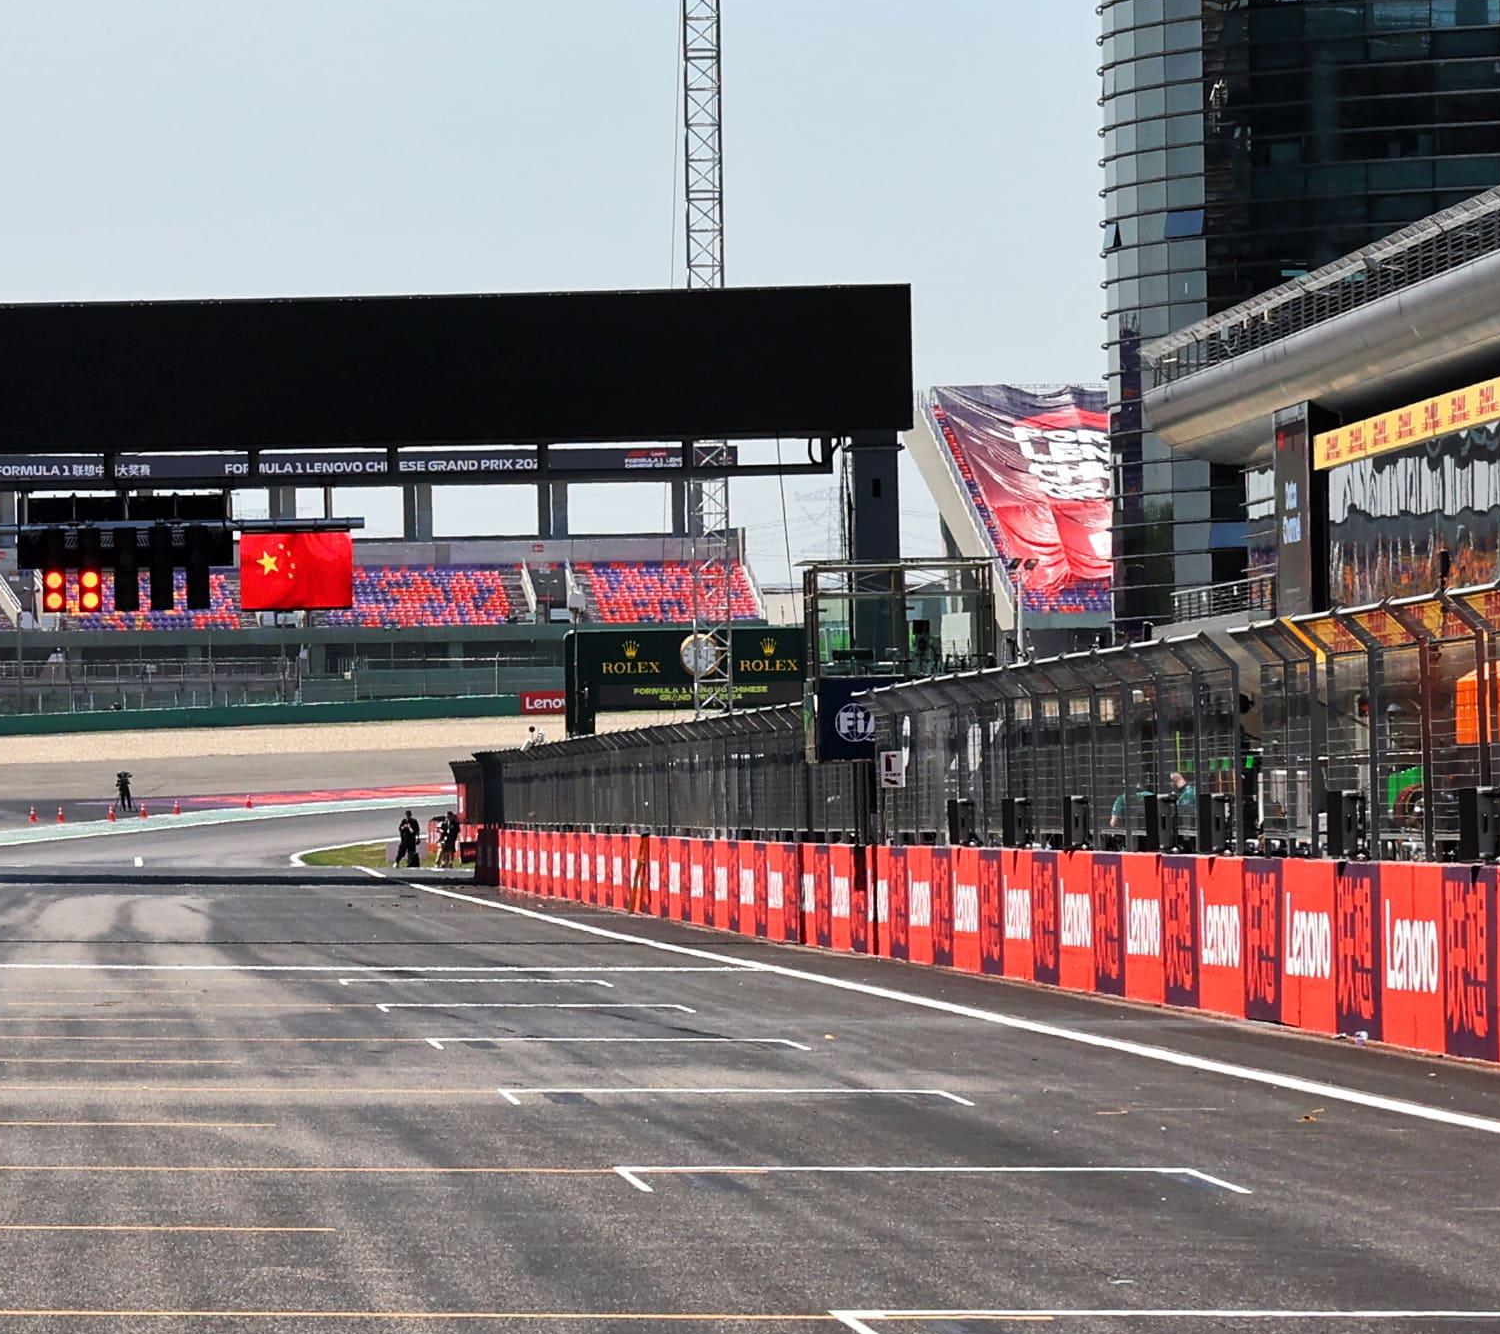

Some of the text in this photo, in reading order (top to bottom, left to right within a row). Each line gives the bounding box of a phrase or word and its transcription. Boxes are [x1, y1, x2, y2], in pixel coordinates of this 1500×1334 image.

[62, 465, 70, 476] 1
[72, 464, 151, 476] 联想中大奖赛
[295, 463, 304, 473] 1
[306, 461, 363, 473] LENOVO
[366, 460, 426, 473] CHIESE
[428, 460, 478, 472] GRAND
[481, 459, 513, 470] PRIX
[515, 458, 538, 470] 202
[602, 662, 661, 674] ROLEX
[739, 659, 800, 672] ROLEX
[525, 695, 567, 711] Lenov
[1003, 875, 1031, 940] Lenovo
[1060, 878, 1091, 948] Lenovo
[1125, 883, 1160, 957] Lenovo
[1200, 889, 1241, 968] Lenovo
[1286, 892, 1331, 980] Lenovo
[1386, 899, 1438, 994] Lenovo
[1445, 880, 1488, 1038] 联想
